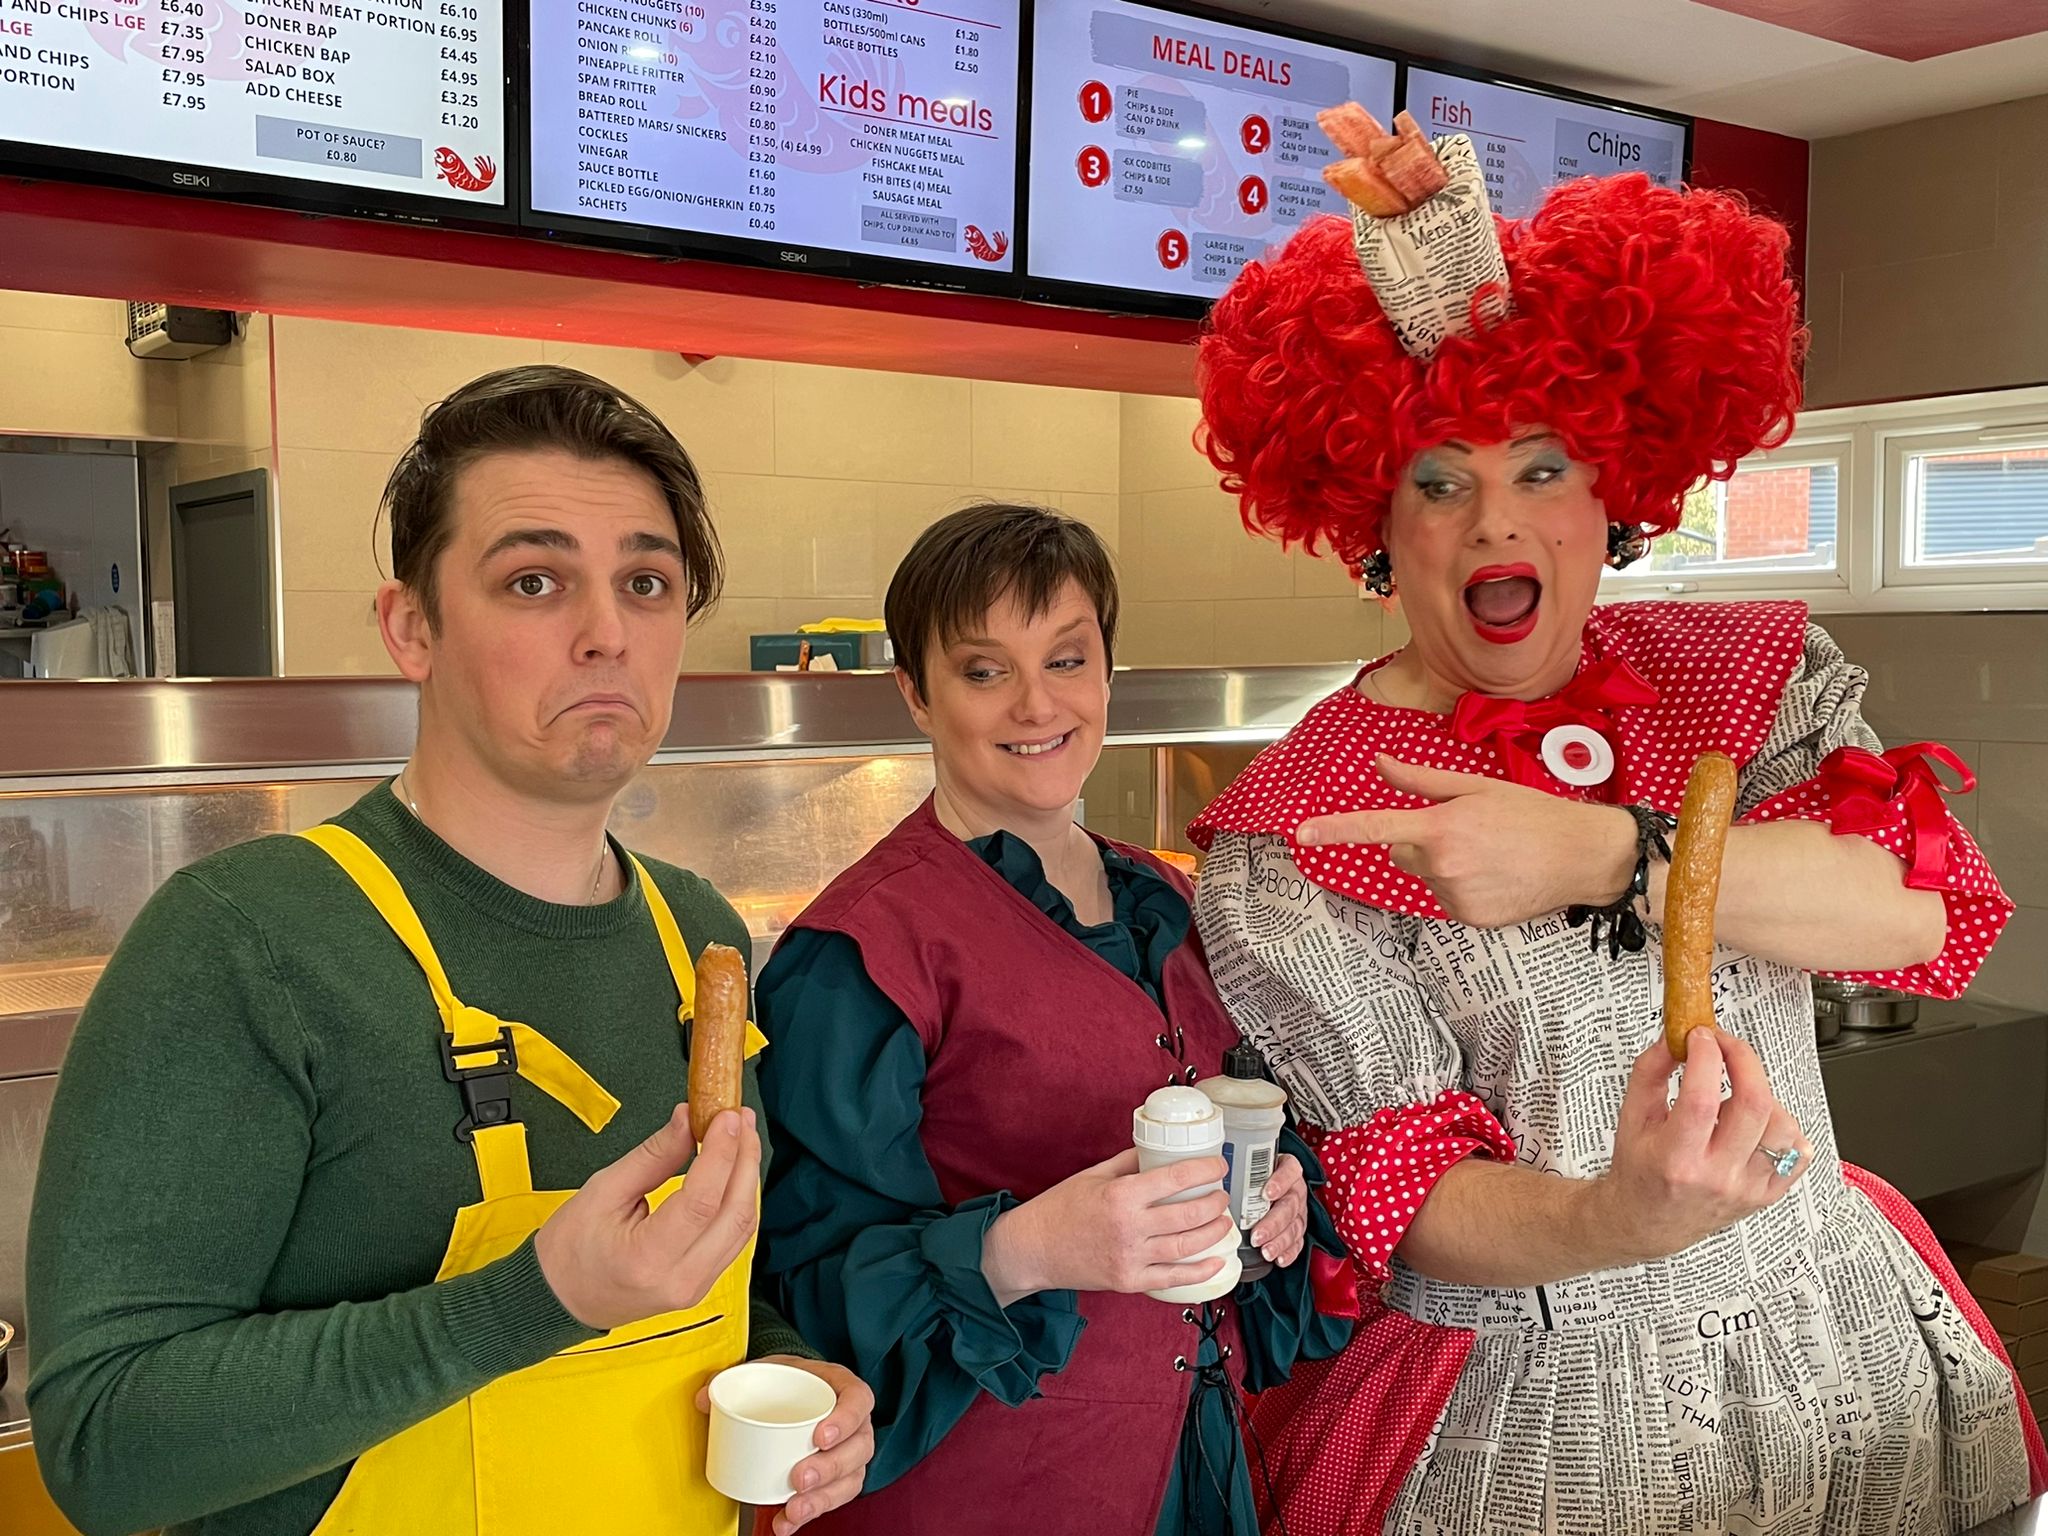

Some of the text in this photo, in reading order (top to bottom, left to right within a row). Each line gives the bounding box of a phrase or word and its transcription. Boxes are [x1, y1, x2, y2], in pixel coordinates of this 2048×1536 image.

[160, 0, 204, 17] £6.40
[440, 3, 477, 20] £6.10
[685, 5, 705, 19] (10)
[750, 0, 776, 13] £3.95
[823, 2, 888, 25] CANS (330ml)
[11, 0, 51, 14] AND
[58, 4, 109, 24] CHIPS
[114, 13, 146, 31] LGE
[320, 4, 435, 35] MEAT PORTION
[578, 1, 693, 35] CHICKEN CHUNKS (6)
[750, 16, 776, 30] £4.20
[0, 19, 33, 36] LGE
[161, 21, 204, 40] £7.35
[245, 12, 337, 39] DONER BAP
[441, 25, 477, 42] £6.95
[578, 19, 662, 44] PANCAKE ROLL
[824, 18, 926, 48] BOTTLES/500ml CANS
[750, 34, 776, 47] £4.20
[956, 29, 979, 42] £1.20
[162, 45, 205, 64] £7.95
[245, 36, 350, 64] CHICKEN BAP
[578, 37, 618, 55] ONION
[823, 35, 898, 59] LARGE BOTTLES
[955, 45, 979, 58] £1.80
[37, 49, 90, 69] CHIPS
[441, 47, 477, 64] £4.45
[750, 50, 776, 64] £2.10
[1153, 35, 1292, 87] MEAL DEALS
[245, 58, 335, 84] SALAD BOX
[578, 55, 685, 84] PINEAPPLE FRITTER
[750, 67, 776, 81] £2.20
[955, 61, 979, 74] £2.50
[0, 69, 75, 91] ORTION
[162, 68, 205, 87] £7.95
[441, 69, 477, 86] £4.95
[578, 72, 657, 96] SPAM FRITTER
[246, 82, 342, 108] ADD CHEESE
[442, 91, 478, 107] £3.25
[750, 84, 776, 97] £0.90
[163, 92, 206, 110] £7.95
[578, 90, 648, 111] BREAD ROLL
[750, 101, 776, 114] £2.10
[819, 73, 992, 131] Kids meals
[1090, 91, 1101, 114] 1
[1151, 105, 1157, 113] &
[1158, 107, 1174, 117] SIDE
[1431, 96, 1472, 127] Fish
[442, 113, 478, 129] £1.20
[578, 108, 635, 126] BATTERED
[676, 123, 727, 141] SNICKERS
[750, 117, 776, 130] £0.80
[1145, 116, 1154, 125] OF
[1156, 118, 1180, 129] DRINK
[297, 128, 385, 150] POT OF SAUCE?
[578, 126, 628, 143] COCKLES
[863, 124, 953, 148] DONER MEAT MEAL
[1250, 125, 1262, 147] 2
[578, 143, 629, 160] VINEGAR
[780, 139, 794, 152] (4)
[796, 142, 822, 155] £4.99
[850, 138, 965, 166] CHICKEN NUGGETS MEAL
[1308, 146, 1329, 156] DRINK
[1588, 131, 1641, 166] Chips
[327, 150, 356, 163] £0.80
[750, 151, 775, 164] £3.20
[1559, 156, 1578, 168] CONE
[578, 161, 659, 182] SAUCE BOTTLE
[750, 168, 775, 181] £1.60
[872, 158, 944, 178] FISHCAKE MEAL
[1087, 156, 1100, 179] 3
[172, 172, 210, 187] SEIKI
[863, 172, 952, 195] FISH BITES (4) MEAL
[1148, 175, 1154, 183] &
[1155, 176, 1171, 186] SIDE
[578, 178, 744, 211] PICKLED EGG/ONION/GHERKIN
[750, 184, 775, 197] £1.80
[1247, 186, 1260, 207] 4
[1312, 187, 1326, 196] FISH
[578, 196, 627, 212] SACHETS
[749, 201, 775, 214] £0.75
[872, 190, 943, 209] SAUSAGE MEAL
[1306, 199, 1320, 208] SIDE
[749, 218, 775, 231] £0.40
[880, 211, 894, 220] ALL
[895, 213, 919, 224] SERVED
[887, 223, 901, 232] CUP
[902, 225, 924, 236] DRINK
[925, 229, 941, 238] AND
[942, 231, 955, 240] TOY
[1168, 239, 1180, 261] 5
[1229, 243, 1244, 252] FISH
[780, 251, 807, 264] SEIKI
[1369, 958, 1382, 973] By
[1546, 1040, 1574, 1052] WHAT
[1574, 1309, 1616, 1327] points
[1819, 1446, 1827, 1480] even
